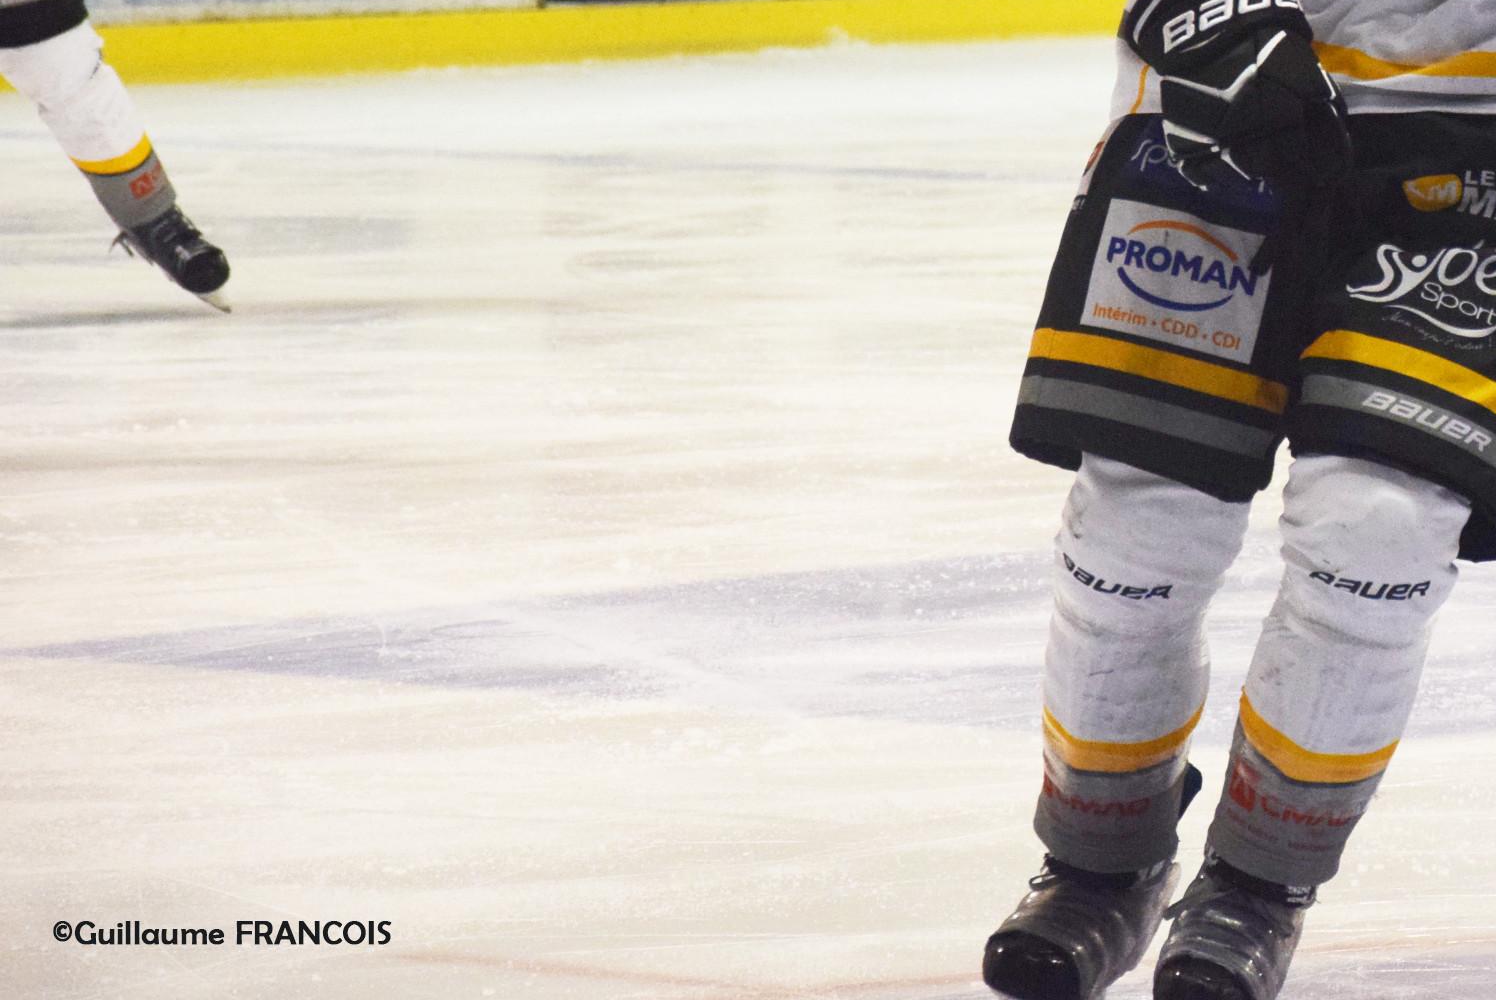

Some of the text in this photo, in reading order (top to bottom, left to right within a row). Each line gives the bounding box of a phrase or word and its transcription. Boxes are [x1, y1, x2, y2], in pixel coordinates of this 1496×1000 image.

[1107, 236, 1261, 297] PROMAN
[1093, 303, 1242, 351] Intérim CDD CDI
[1362, 391, 1492, 452] BAUER
[1309, 570, 1431, 601] BAUER
